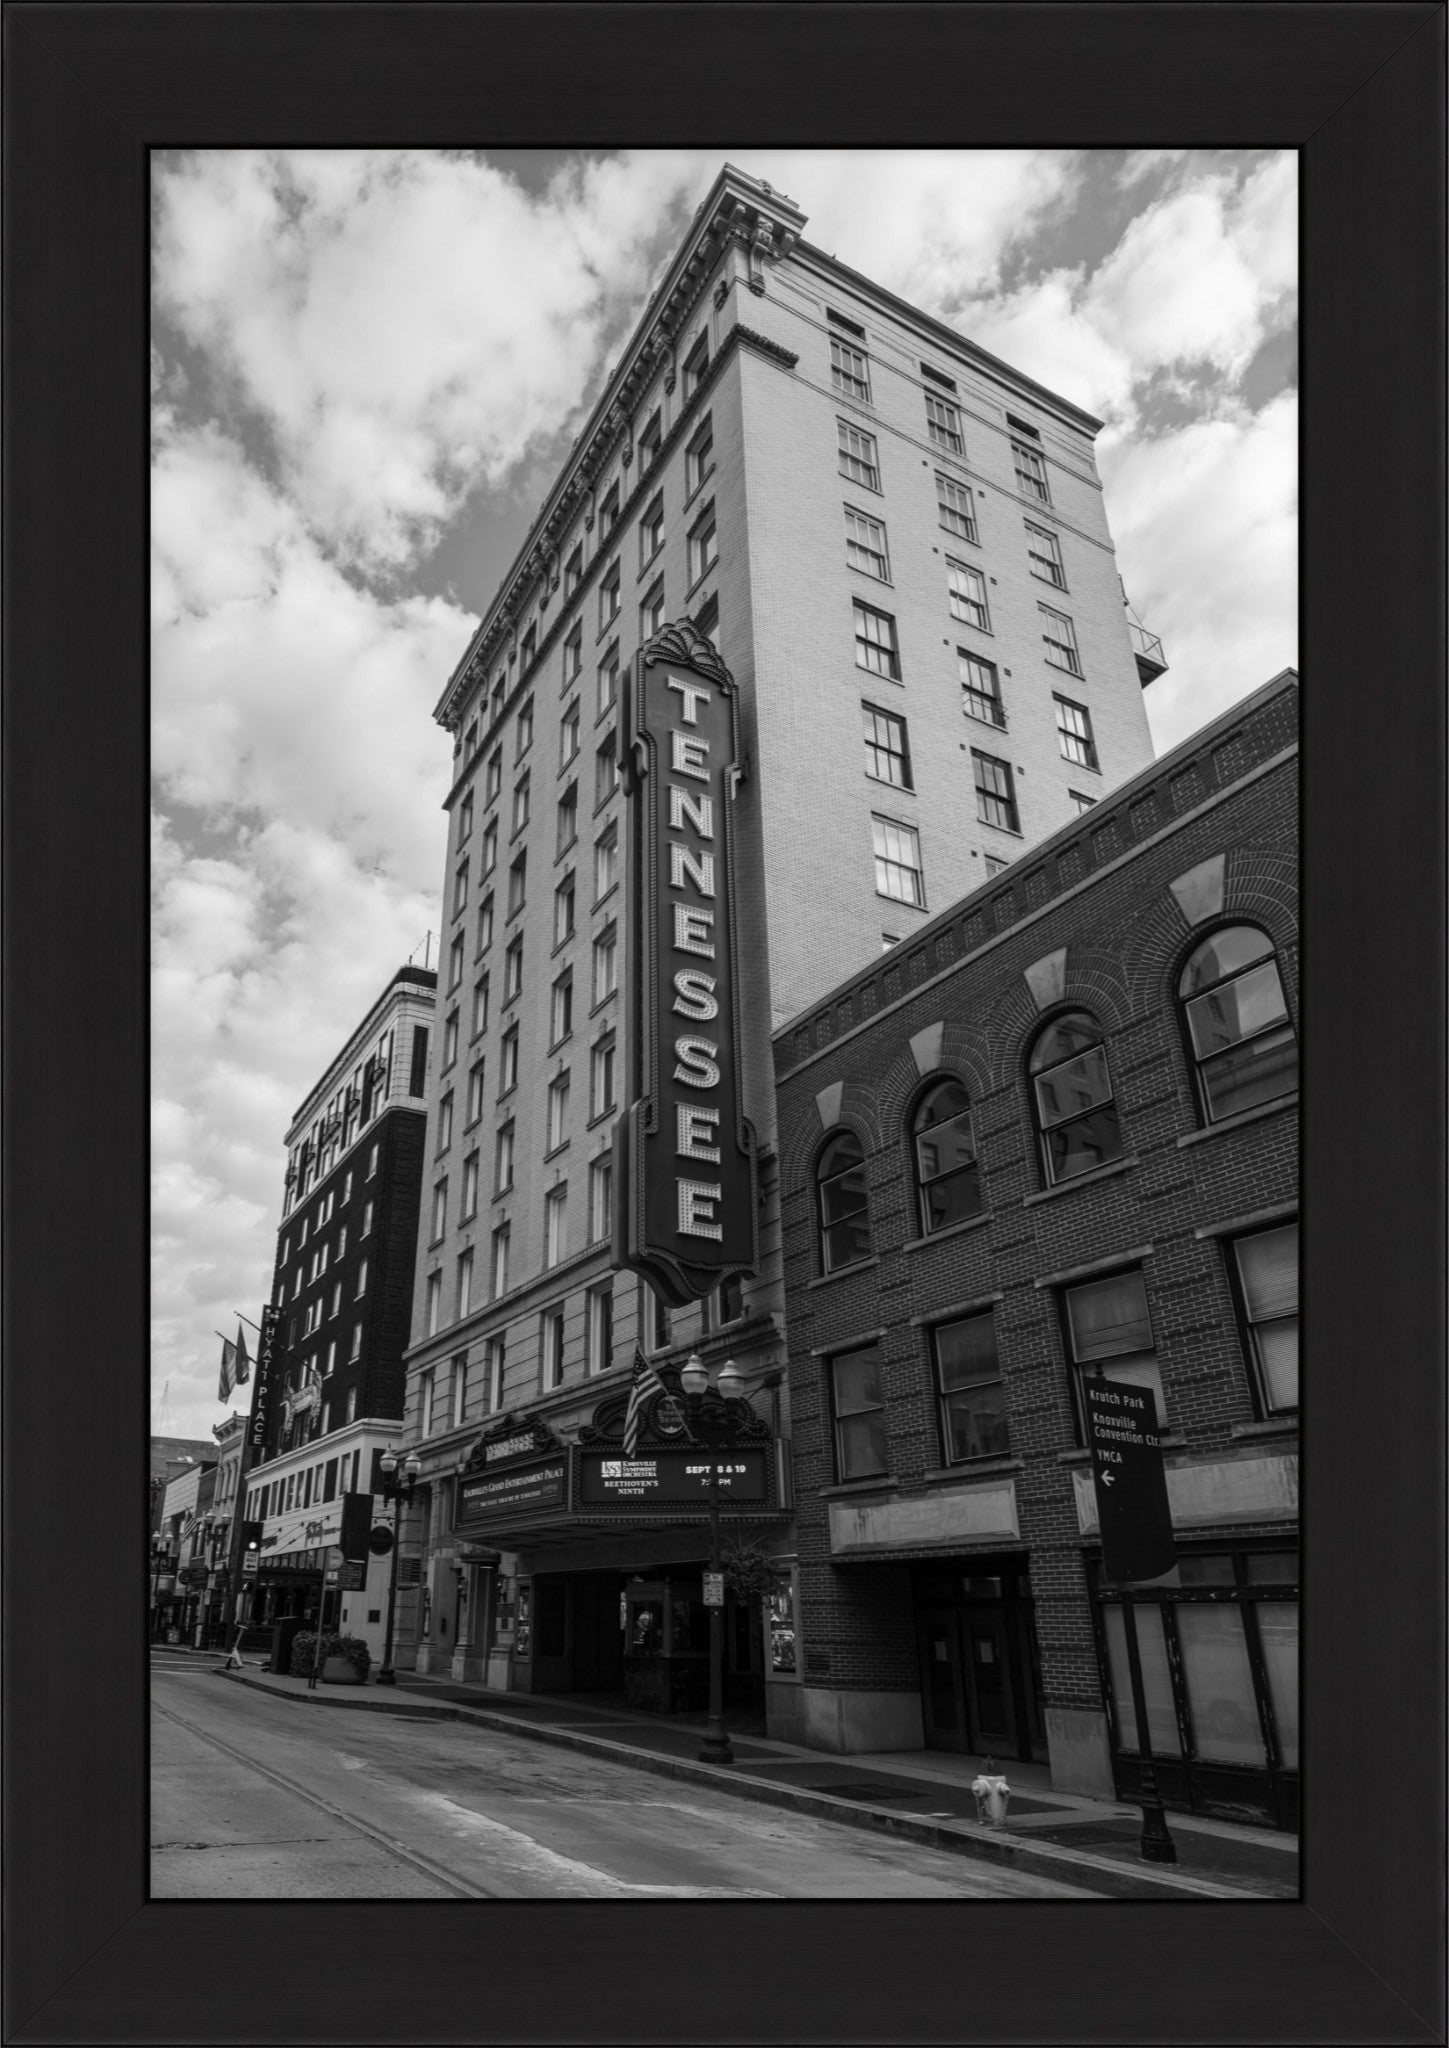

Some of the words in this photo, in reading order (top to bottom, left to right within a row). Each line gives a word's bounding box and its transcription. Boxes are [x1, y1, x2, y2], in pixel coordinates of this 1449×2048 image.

[667, 674, 723, 1242] TENNESSEE
[262, 1327, 275, 1380] HYATT
[1089, 1389, 1121, 1405] Krutch
[1123, 1395, 1145, 1409] Park
[253, 1387, 268, 1445] PLACE
[1093, 1412, 1136, 1430] Knoxville
[1094, 1426, 1144, 1444] Convention
[1097, 1449, 1123, 1464] YMCA
[685, 1465, 711, 1474] SEPT
[725, 1465, 733, 1473] &
[734, 1464, 746, 1473] 19
[604, 1480, 659, 1488] BEETHOVEN'S
[718, 1478, 732, 1486] PM
